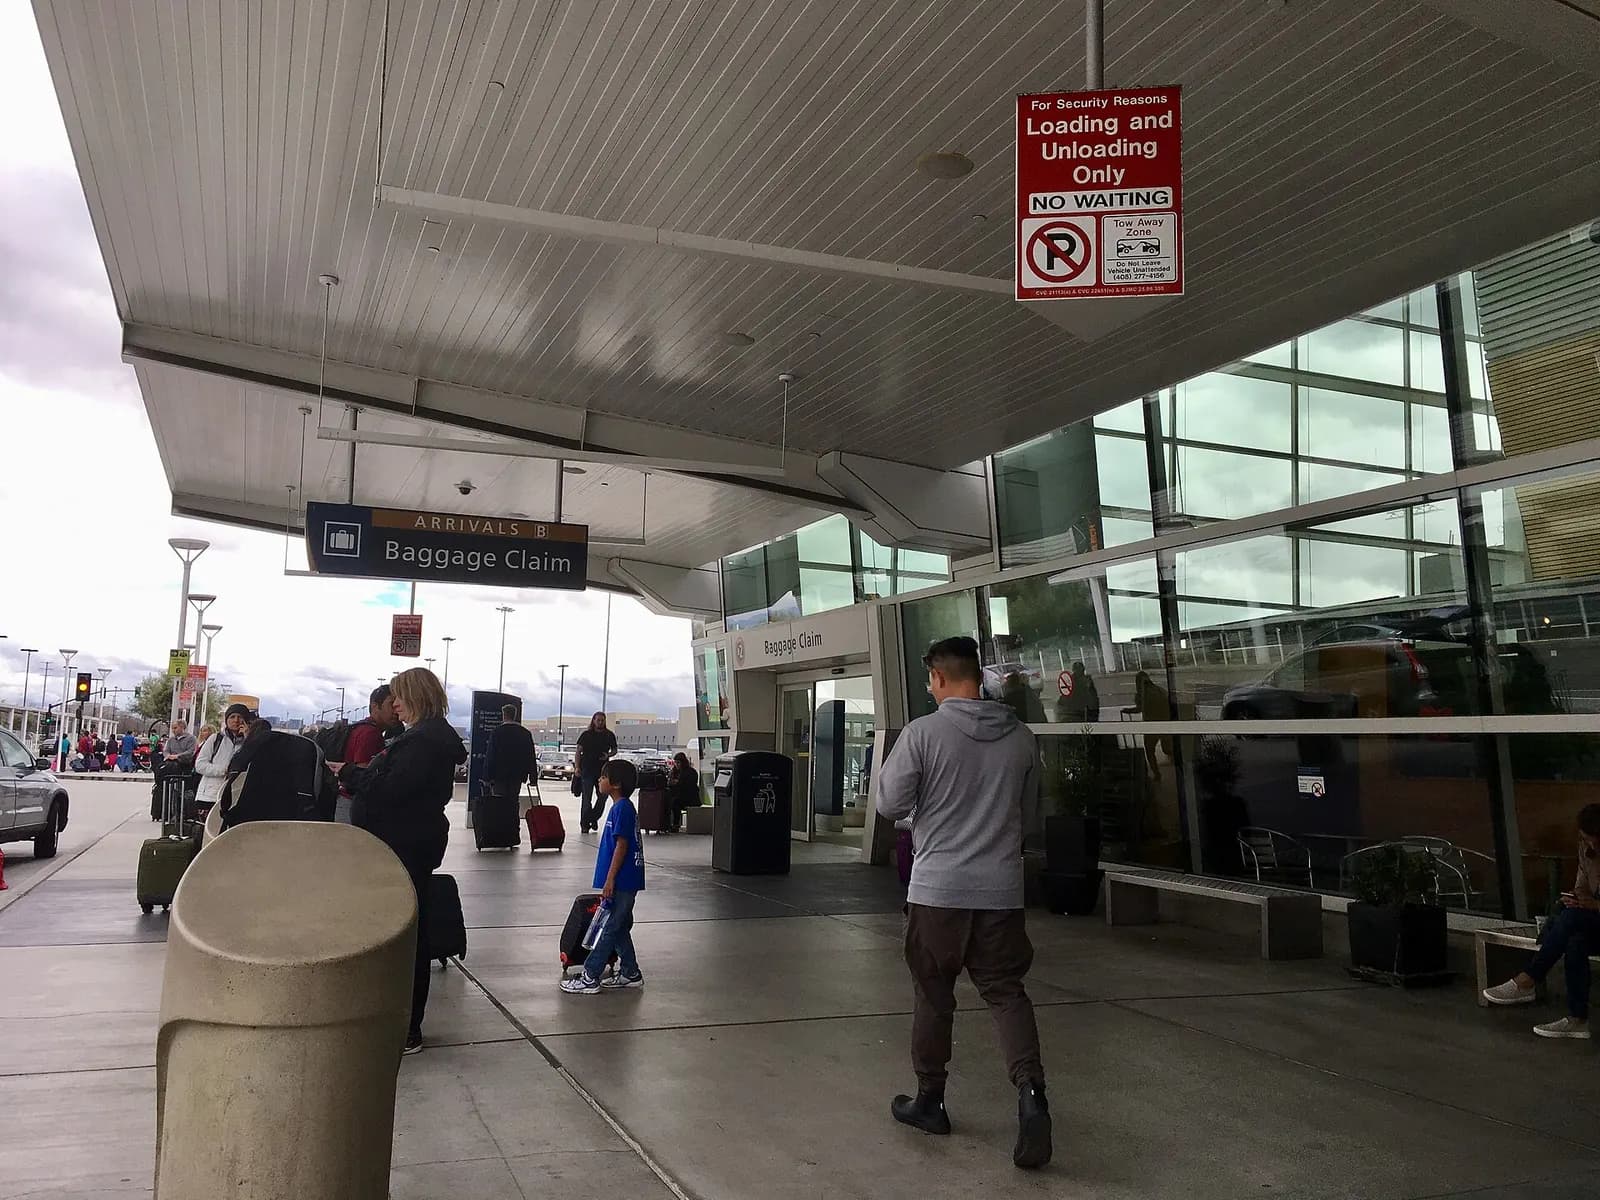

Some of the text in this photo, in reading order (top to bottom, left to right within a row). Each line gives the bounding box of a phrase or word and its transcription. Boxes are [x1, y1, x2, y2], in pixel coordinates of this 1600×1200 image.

[1031, 96, 1168, 110] For Security Reasons
[1027, 110, 1172, 135] Loading and
[1042, 138, 1158, 160] Unloading
[1073, 164, 1126, 186] Only
[1032, 190, 1169, 210] NO WAITING
[1113, 218, 1164, 227] Tow Away
[1126, 228, 1152, 236] Zone
[414, 515, 547, 538] ARRIVALS B
[385, 540, 571, 573] Baggage Claim
[764, 631, 822, 656] Baggage Claim
